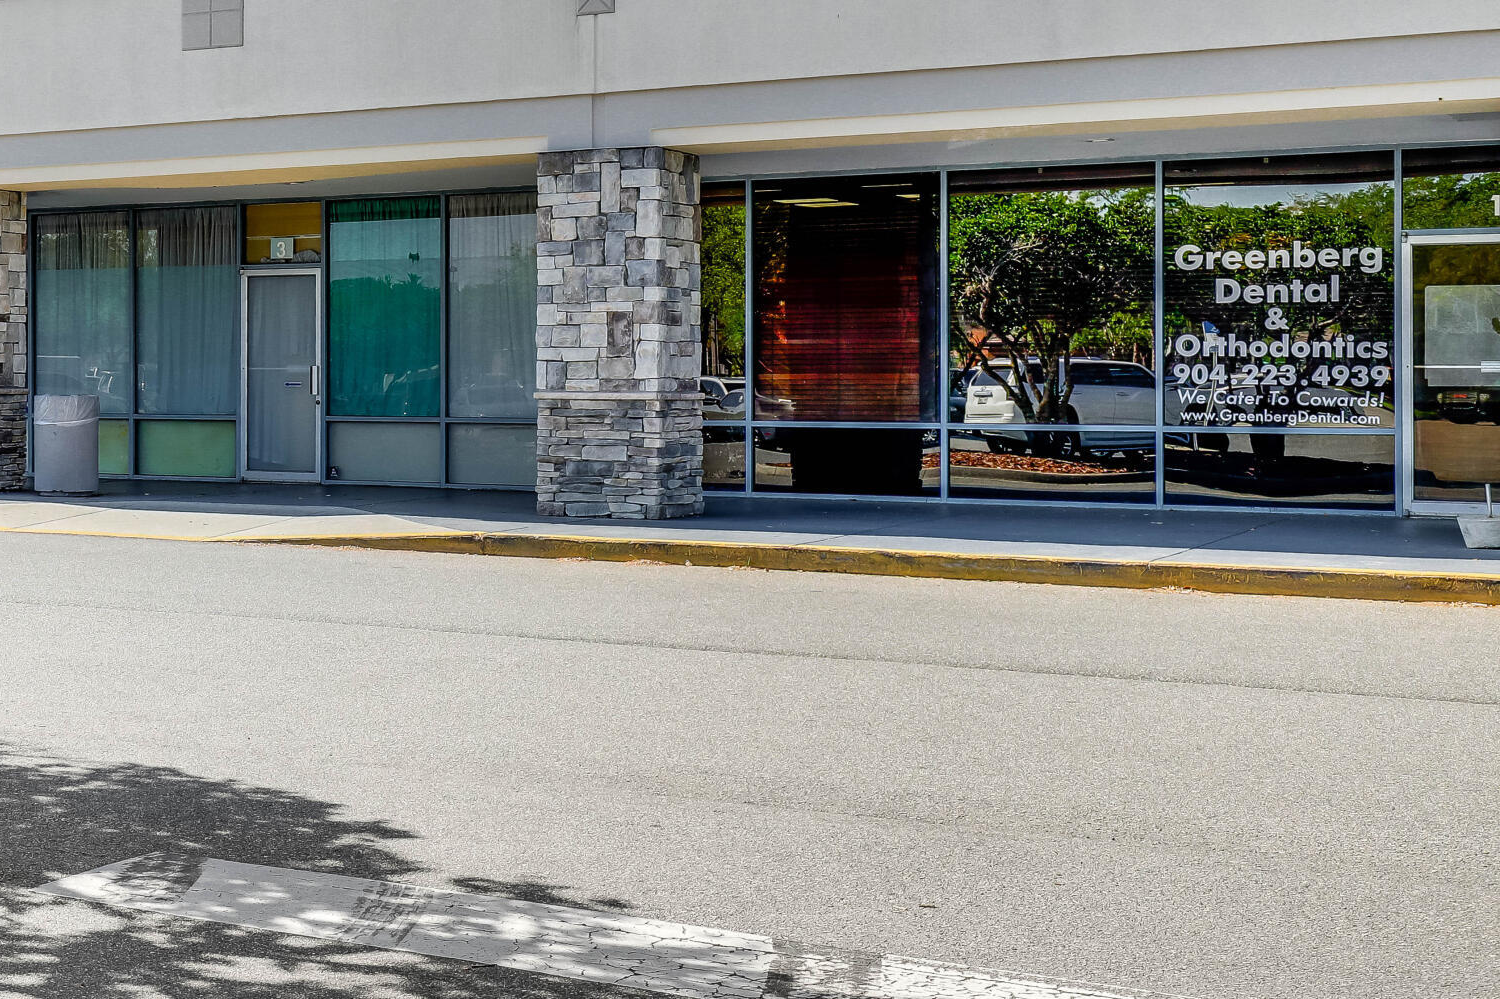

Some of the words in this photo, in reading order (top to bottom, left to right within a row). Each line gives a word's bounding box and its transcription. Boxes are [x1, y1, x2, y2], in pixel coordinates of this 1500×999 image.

[276, 241, 286, 258] 3
[1174, 240, 1383, 274] Greenberg
[1215, 274, 1340, 304] Dental
[1264, 307, 1290, 330] &
[1175, 333, 1389, 359] Orthodontics
[1173, 363, 1390, 387] 904.223.4939
[1177, 389, 1207, 404] We
[1213, 390, 1263, 406] Cater
[1268, 391, 1290, 406] To
[1296, 391, 1385, 408] Cowards!
[1180, 409, 1381, 425] www.GreenbergDental.com
